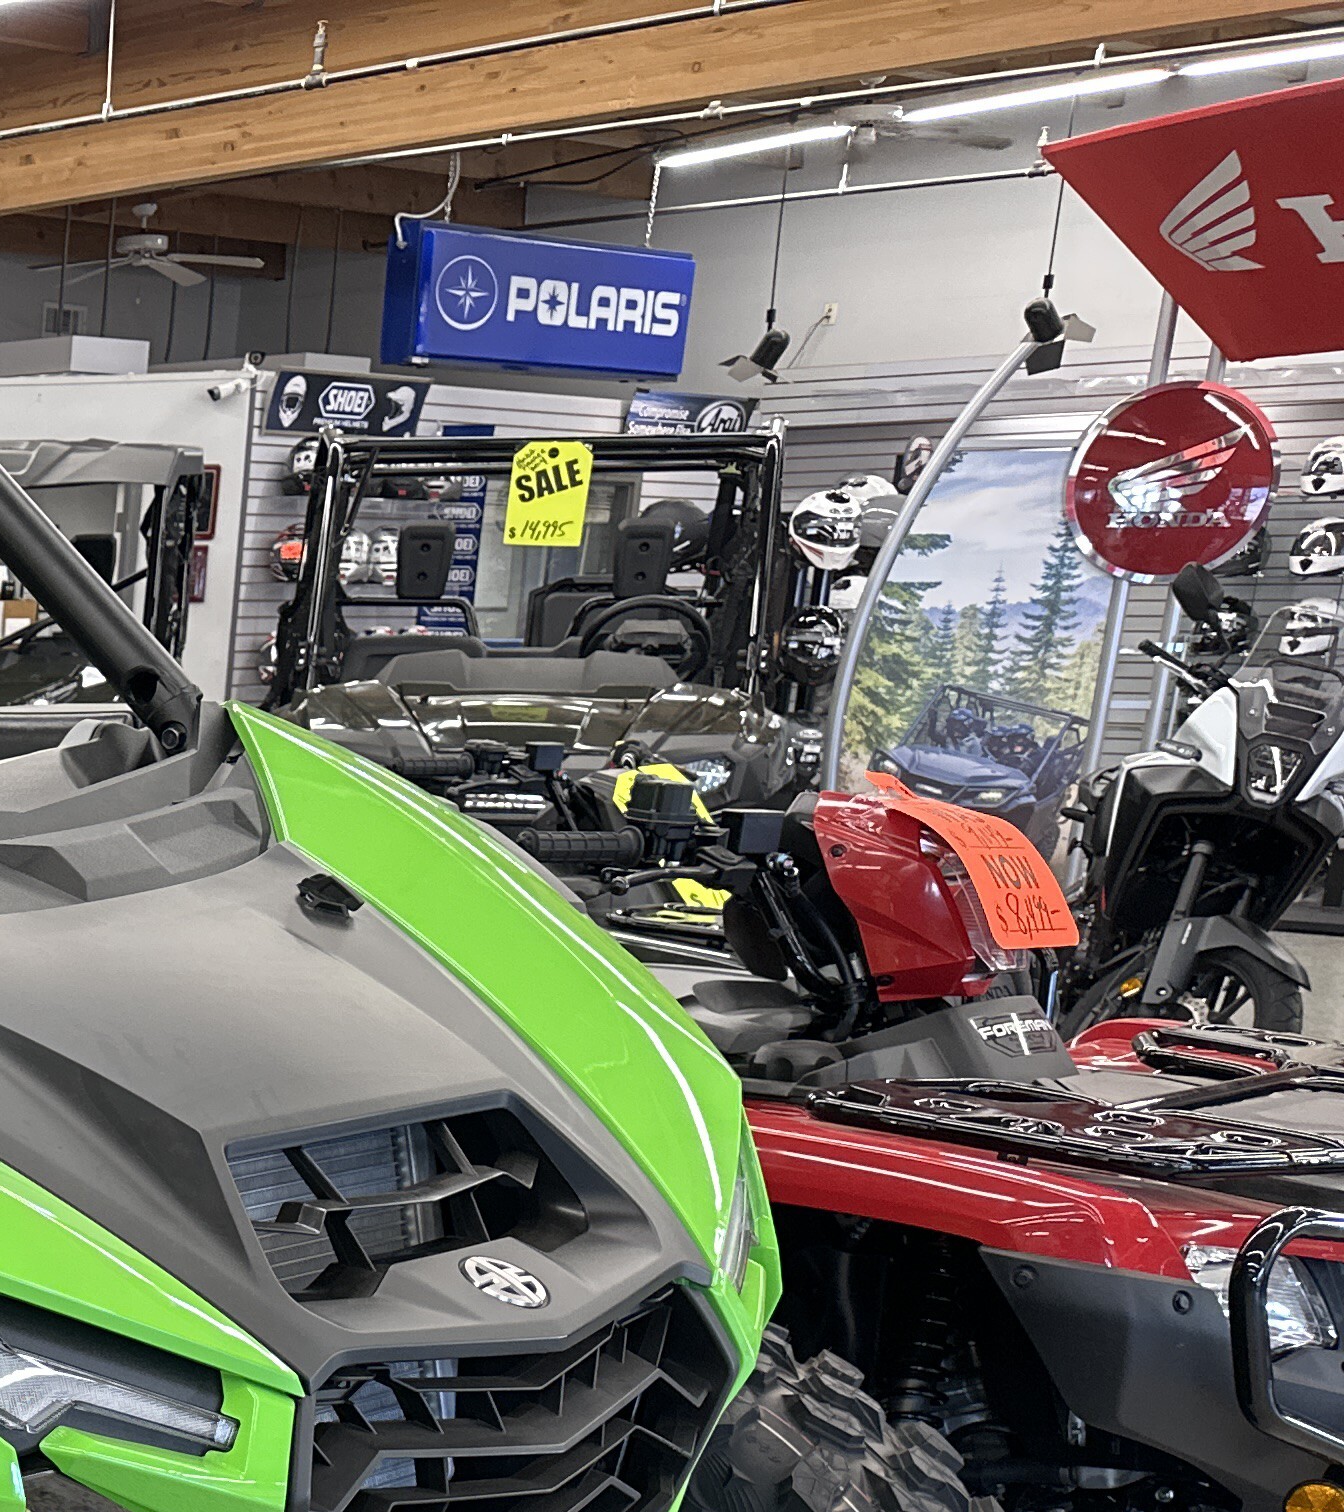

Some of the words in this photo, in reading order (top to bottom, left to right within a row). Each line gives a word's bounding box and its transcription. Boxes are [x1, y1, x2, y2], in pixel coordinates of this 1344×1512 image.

[506, 275, 681, 337] POLARIS
[325, 387, 369, 413] SHOEI
[638, 404, 690, 420] Compromise
[515, 458, 583, 503] SALE
[1106, 508, 1231, 528] HONDA
[508, 526, 516, 539] $
[980, 855, 1040, 889] NOW
[978, 1019, 1053, 1040] FOREMAN
